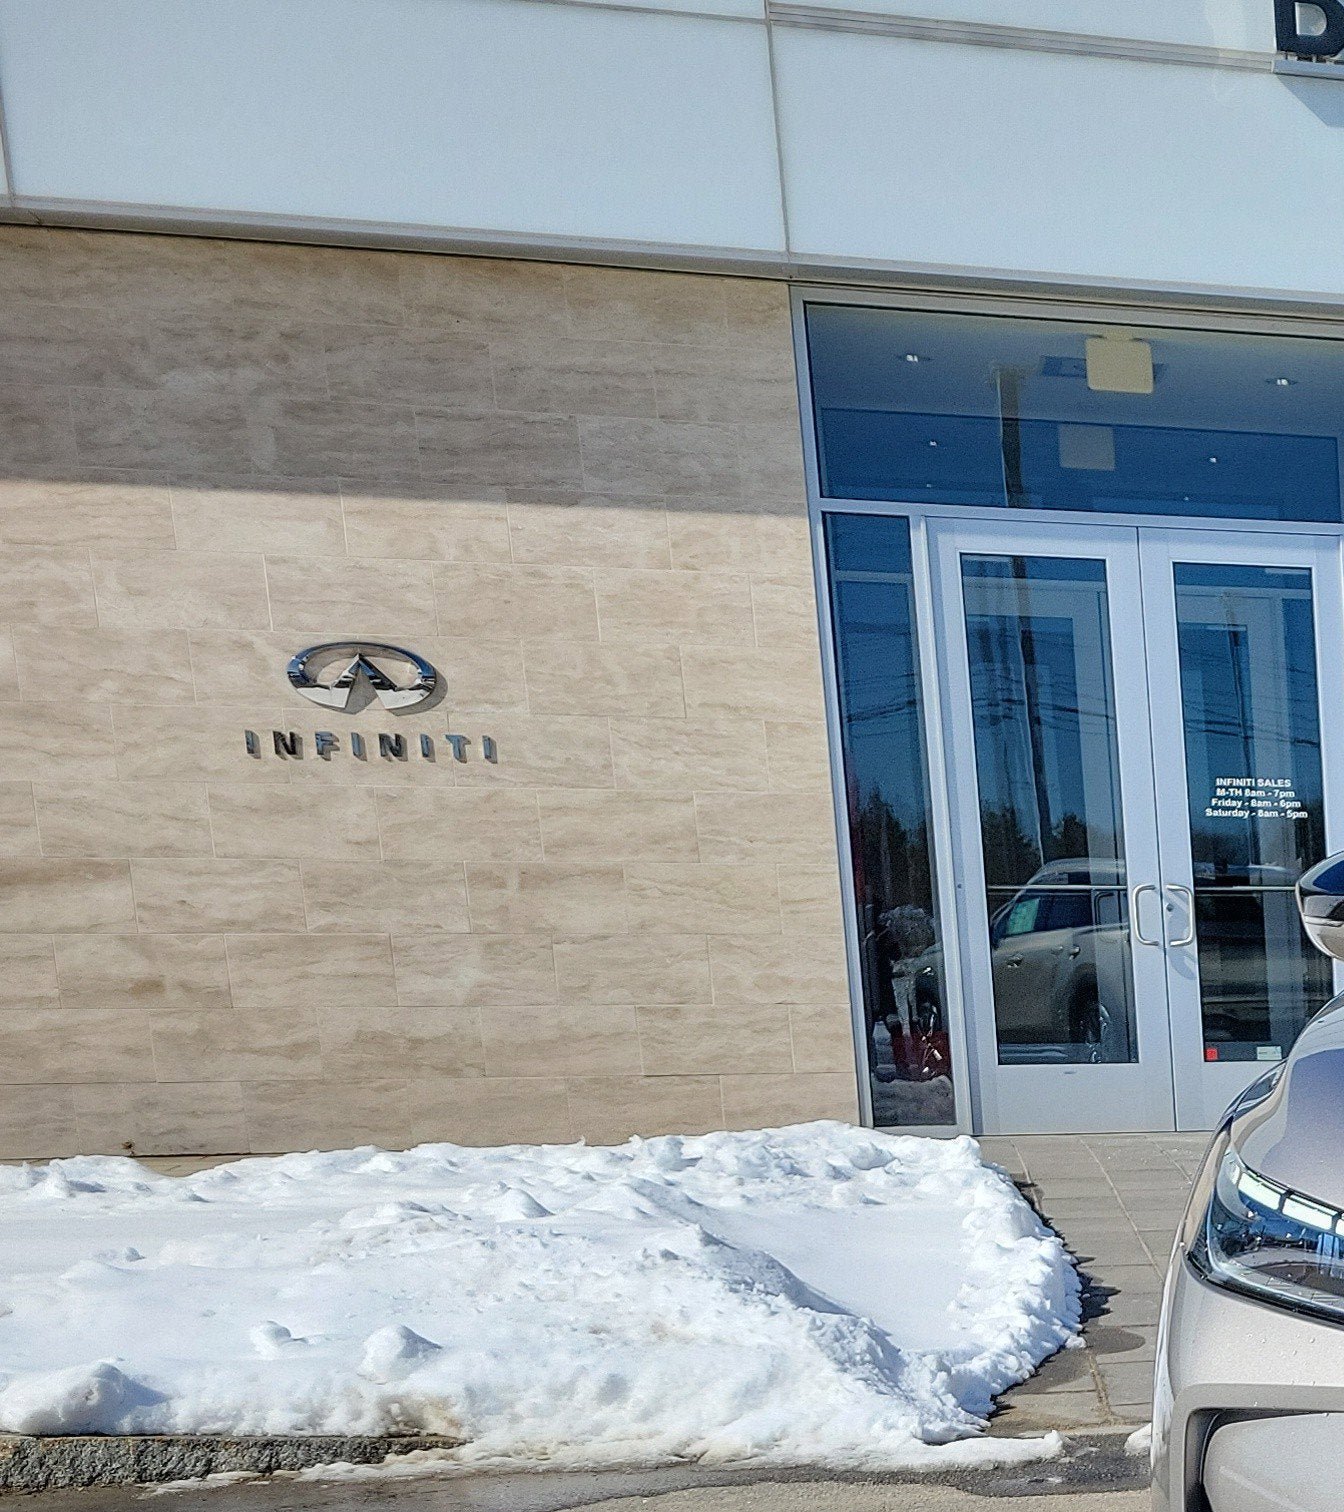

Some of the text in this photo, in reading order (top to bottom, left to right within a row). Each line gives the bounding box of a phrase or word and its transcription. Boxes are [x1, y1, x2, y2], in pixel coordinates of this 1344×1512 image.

[244, 729, 493, 761] INFINITI
[1216, 778, 1292, 787] INFINITI SALES
[1216, 788, 1243, 796] M-TH
[1244, 788, 1266, 797] 8am
[1273, 789, 1295, 798] 7pm
[1211, 798, 1243, 808] Friday
[1250, 799, 1272, 807] 8am
[1279, 800, 1301, 809] 6pm
[1205, 808, 1250, 819] Saturday
[1257, 809, 1279, 817] 8am
[1286, 809, 1308, 819] 5pm
